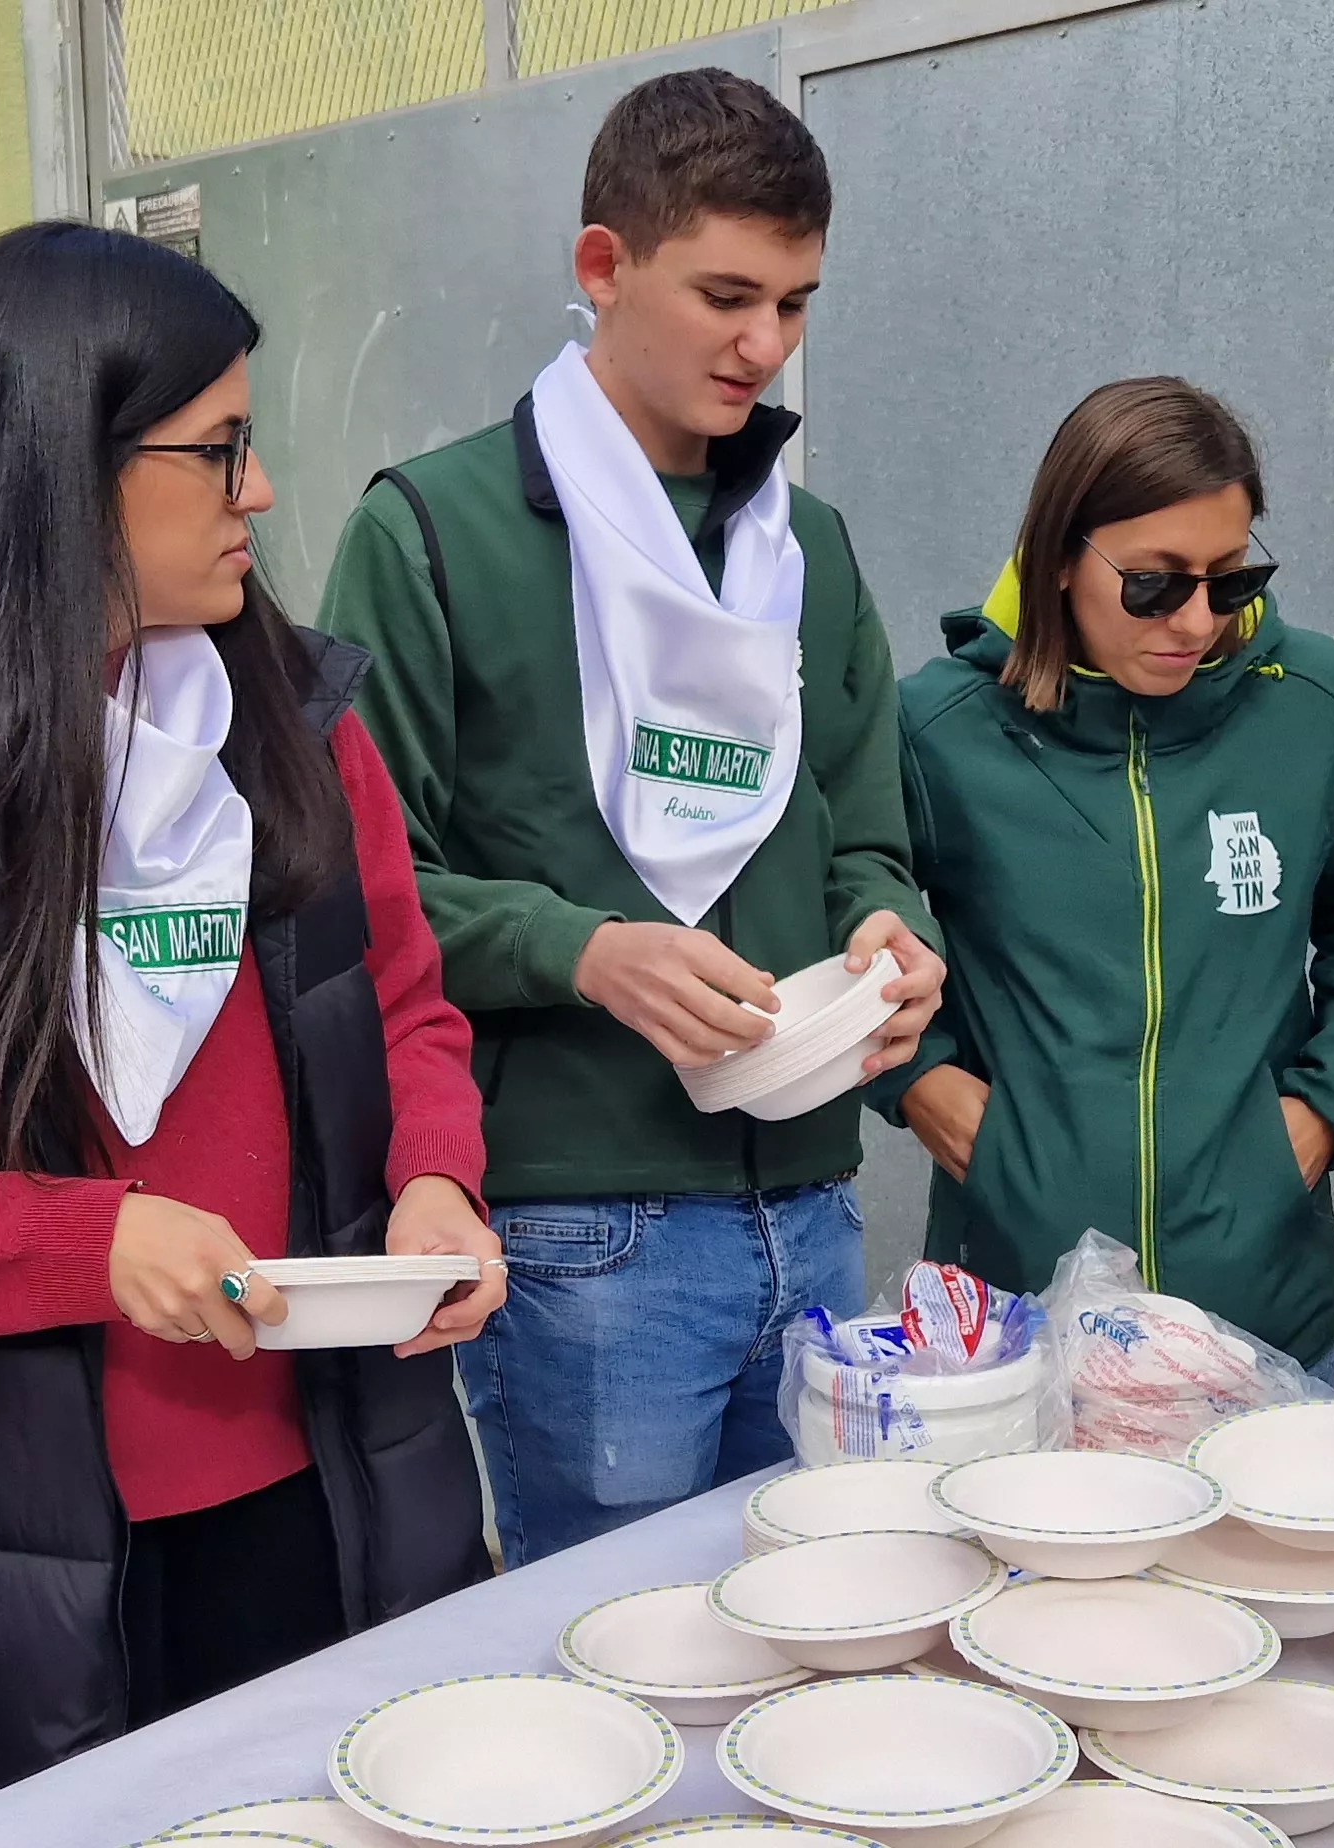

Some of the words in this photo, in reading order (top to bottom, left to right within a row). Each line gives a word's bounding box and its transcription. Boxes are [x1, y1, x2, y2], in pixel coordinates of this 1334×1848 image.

[635, 731, 660, 771] VIVA
[668, 737, 703, 777] SAN
[705, 744, 770, 787] MARTIN
[1233, 820, 1257, 834] VIVA
[1227, 836, 1260, 858] SAN
[1231, 860, 1262, 880] MAR
[1232, 881, 1263, 909] TIN
[112, 918, 161, 963] SAN
[167, 913, 241, 961] MARTIN
